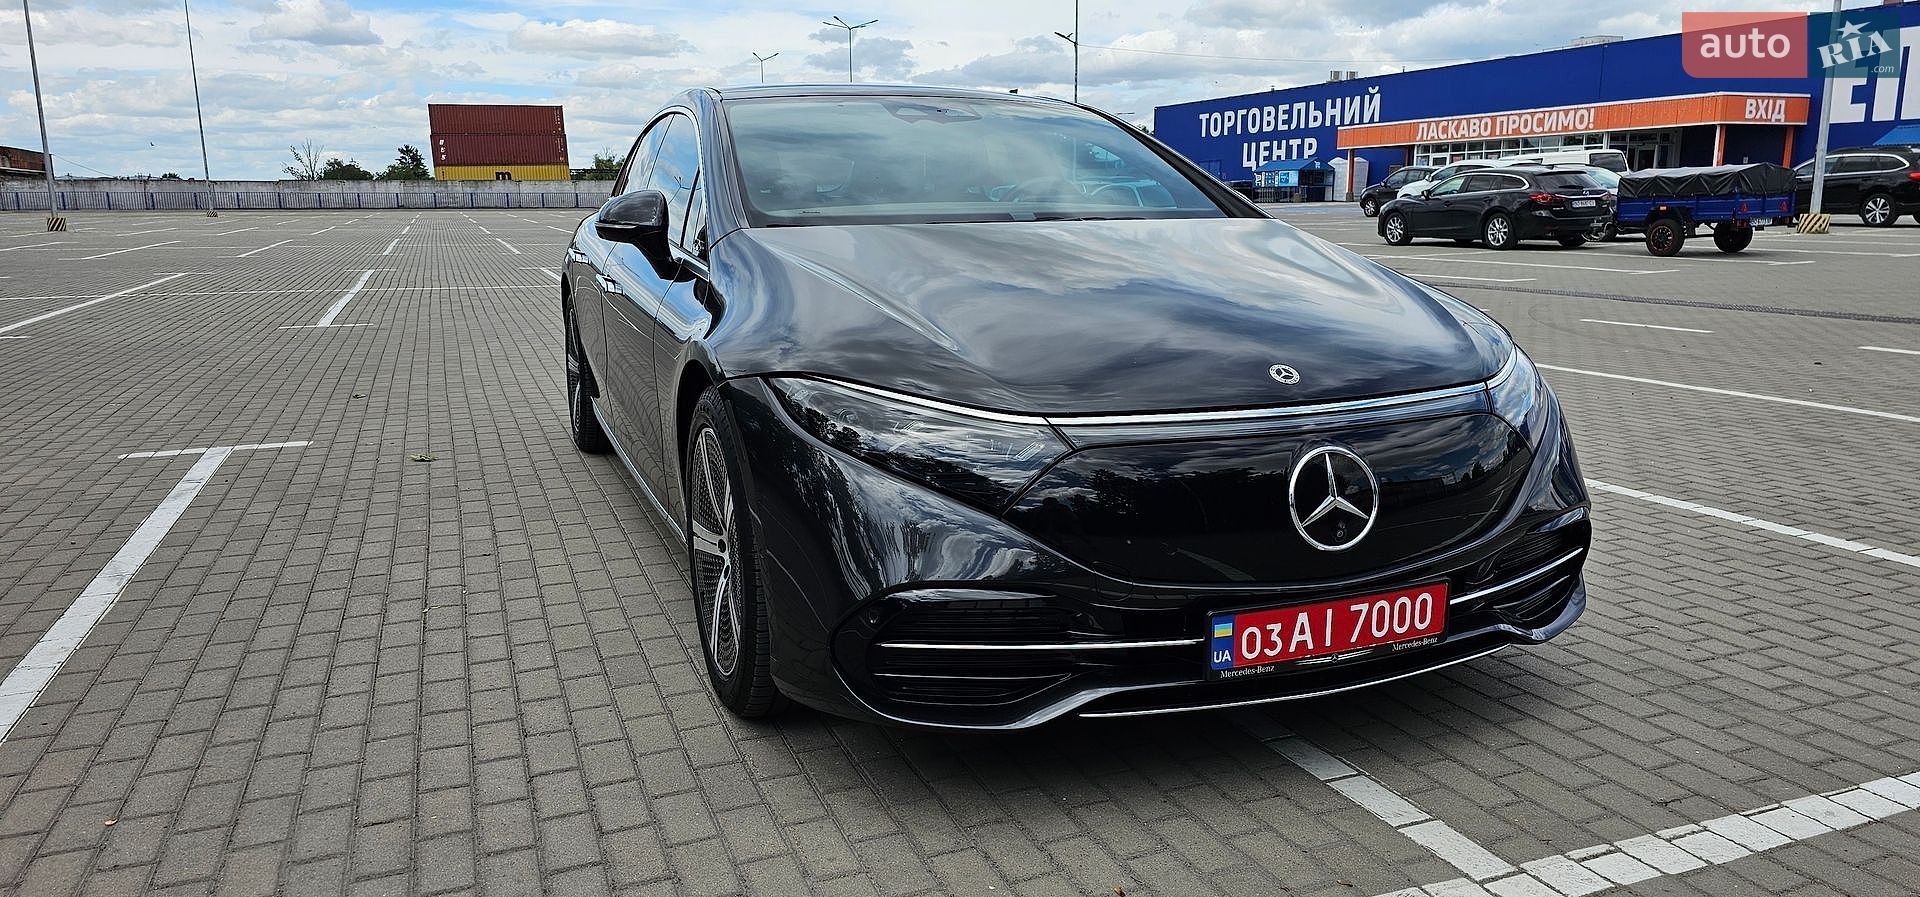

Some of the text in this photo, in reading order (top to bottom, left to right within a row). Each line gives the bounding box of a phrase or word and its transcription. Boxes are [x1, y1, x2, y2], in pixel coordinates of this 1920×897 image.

[1199, 86, 1382, 138] ТОРГОВЕЛЬНИЙ
[1416, 107, 1595, 141] ЛАСКАВО ПРОСИМО!
[1745, 98, 1786, 122] ВХІД
[1242, 138, 1318, 172] ЦЕНТР
[1350, 592, 1433, 643] 7000
[1213, 649, 1232, 664] UA
[1392, 636, 1438, 652] Mercedes-Benz
[1220, 664, 1275, 679] Mercedes-Benz
